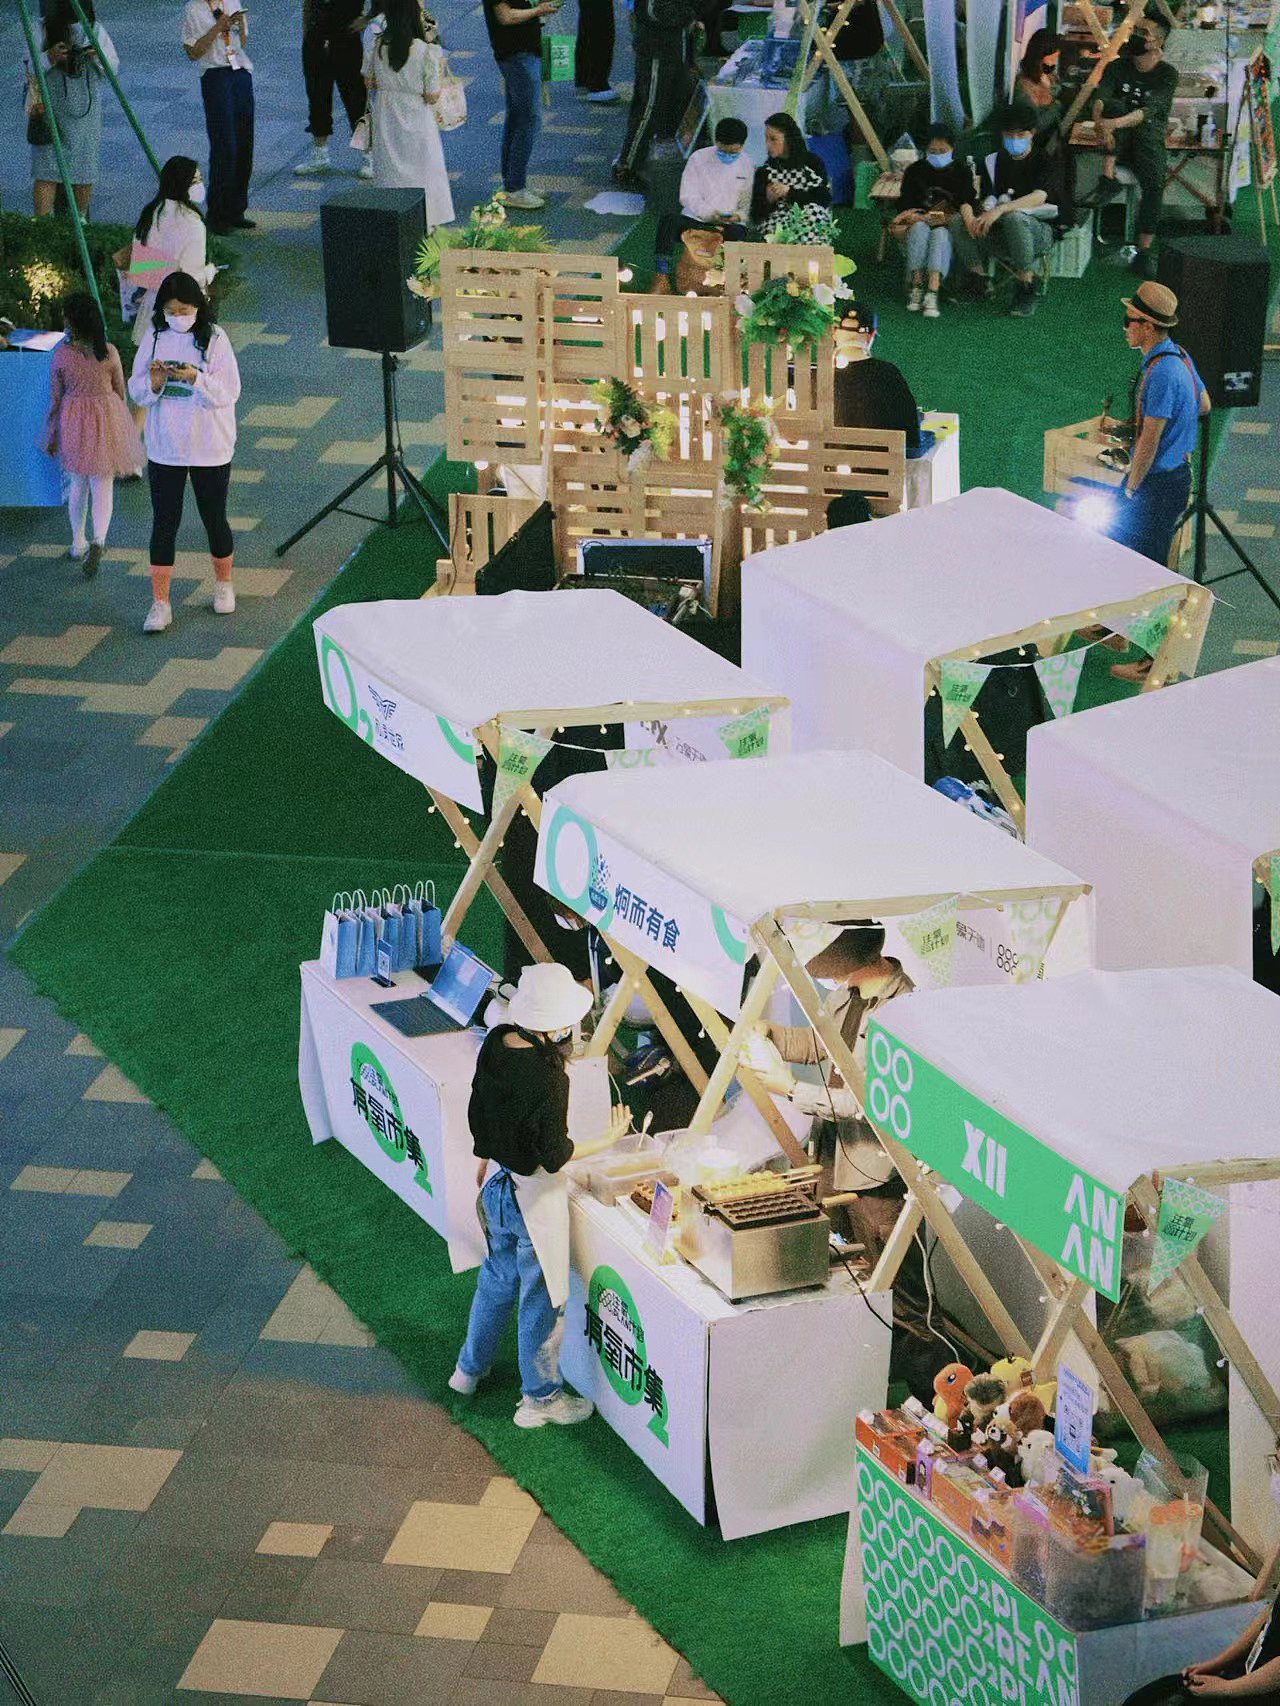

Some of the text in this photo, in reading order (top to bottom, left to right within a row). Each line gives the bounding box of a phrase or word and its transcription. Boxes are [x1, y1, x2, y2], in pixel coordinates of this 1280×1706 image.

[350, 1077, 425, 1171] 有氧市集
[584, 1304, 664, 1419] 有氧市集
